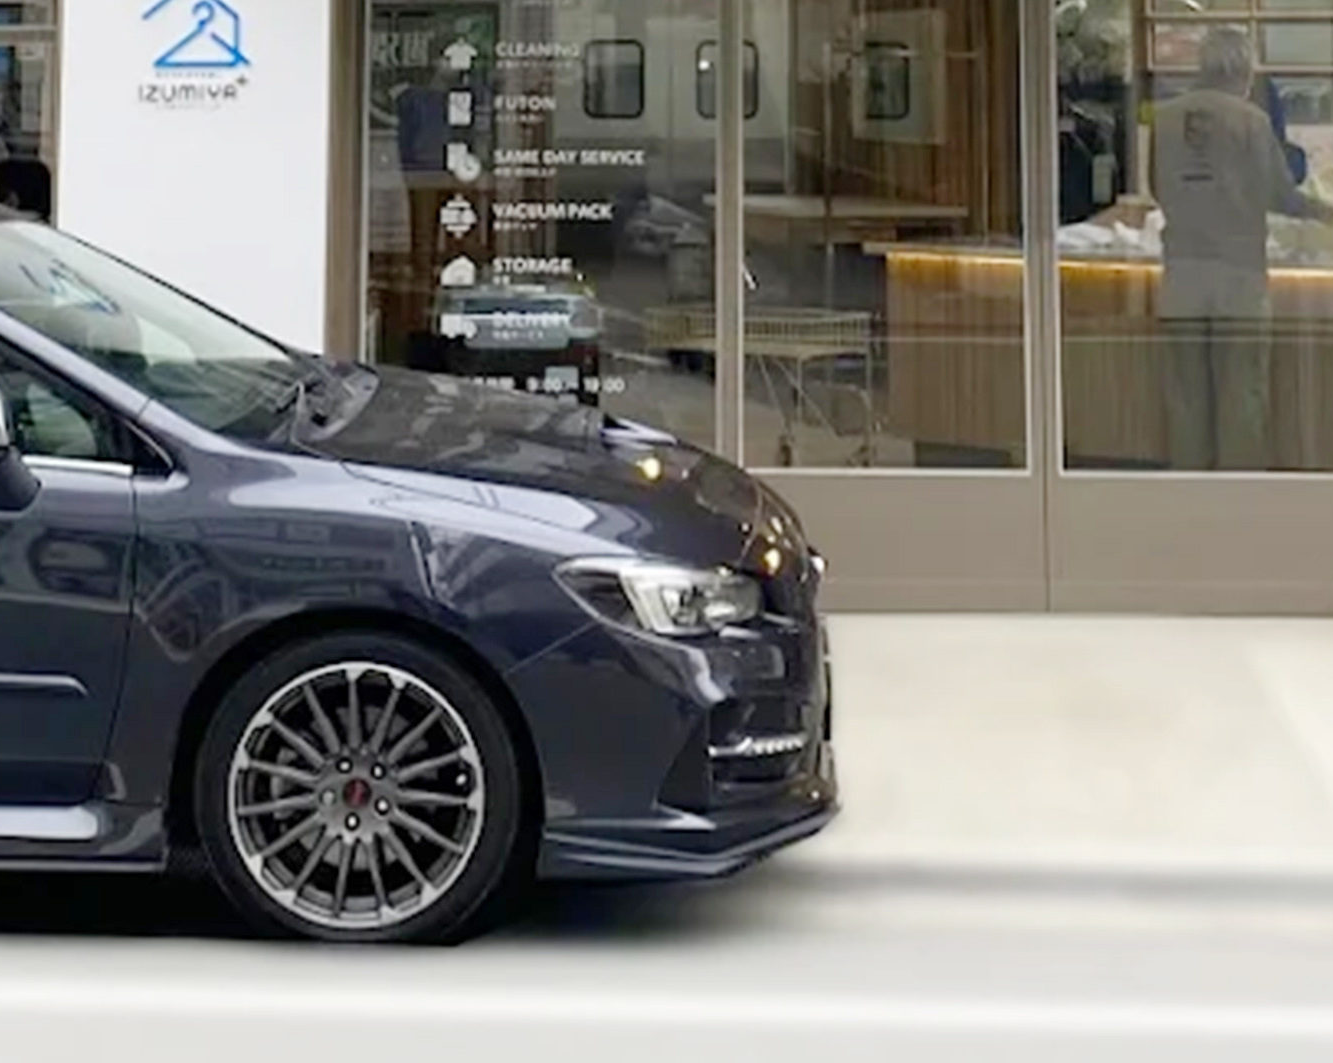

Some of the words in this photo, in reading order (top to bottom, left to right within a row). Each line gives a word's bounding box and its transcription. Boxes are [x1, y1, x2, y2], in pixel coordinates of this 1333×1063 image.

[494, 41, 580, 58] CLEANING
[493, 95, 557, 111] FUTON
[493, 149, 539, 165] SAME
[541, 149, 578, 165] DAY
[579, 149, 645, 165] SERVICE
[492, 202, 565, 220] VACUUM
[567, 203, 613, 220] PACK
[492, 256, 573, 274] STORAGE
[491, 311, 570, 328] DELIVERY
